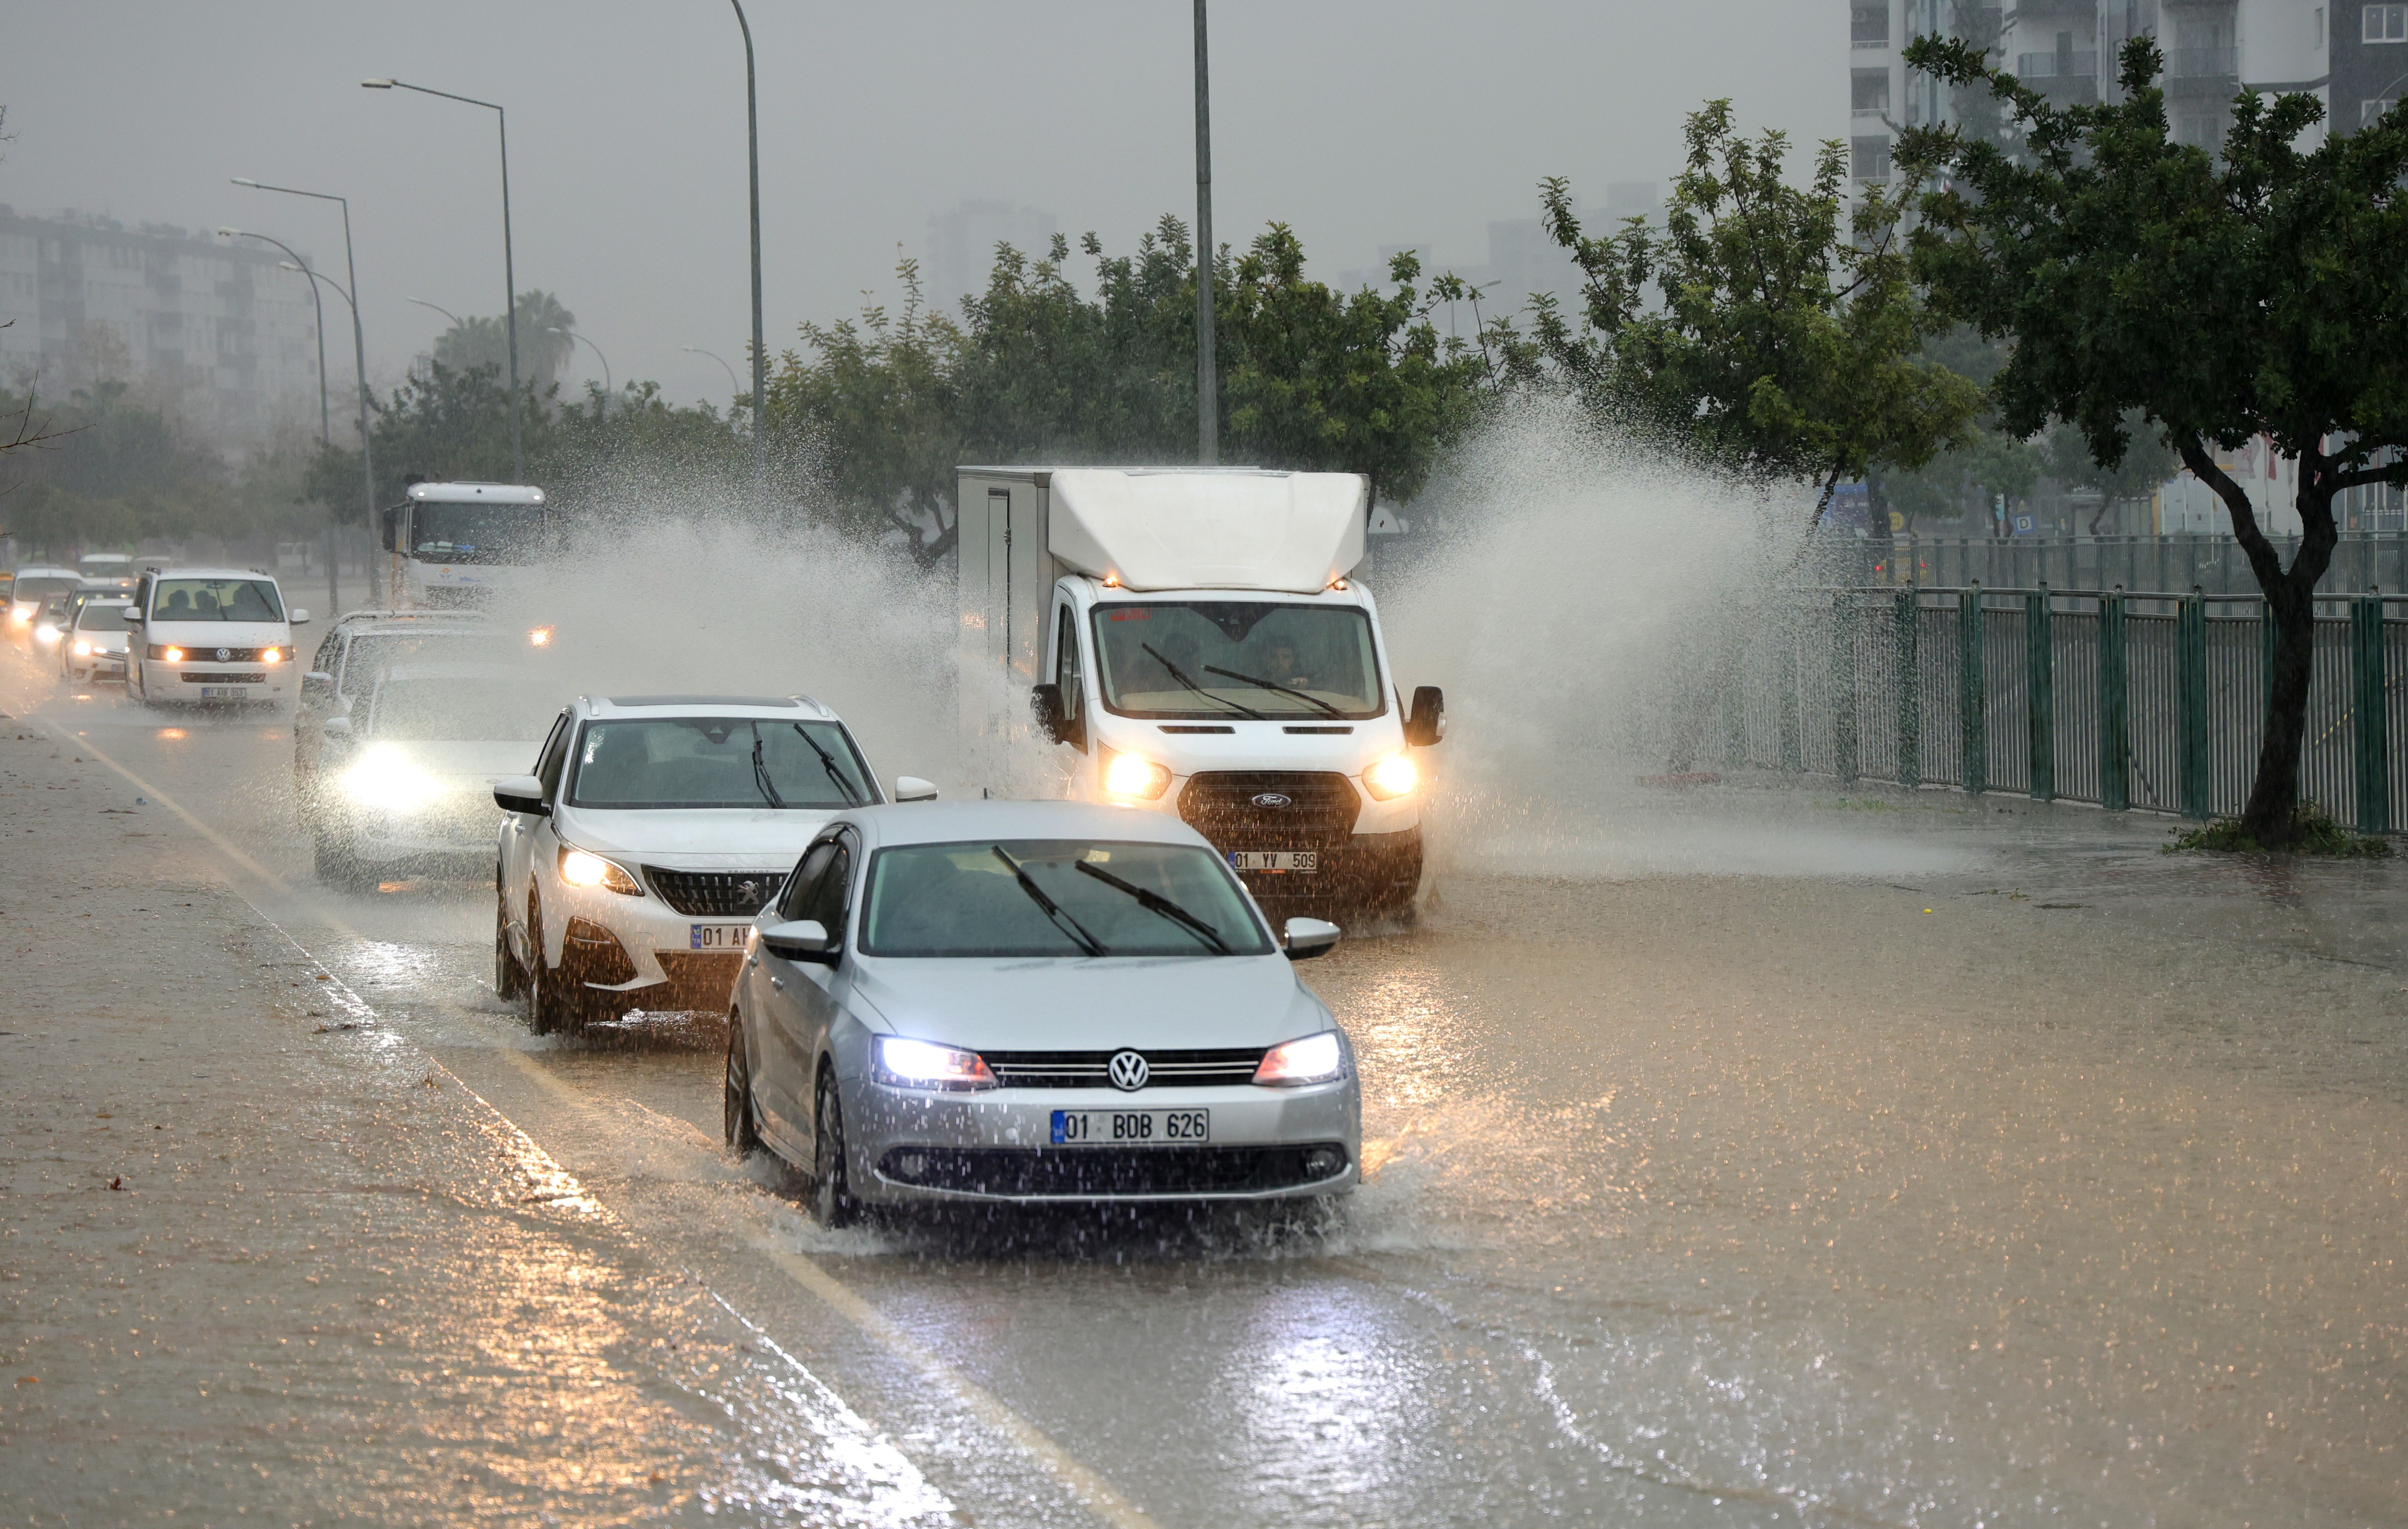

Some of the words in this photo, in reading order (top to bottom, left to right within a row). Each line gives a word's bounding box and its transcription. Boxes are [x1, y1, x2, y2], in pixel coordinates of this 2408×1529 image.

[1261, 795, 1283, 805] Ford
[1235, 853, 1248, 868] 01
[1262, 853, 1277, 868] YV
[1293, 853, 1316, 868] 509
[703, 928, 722, 945] 01
[1065, 1115, 1088, 1139] 01
[1113, 1114, 1152, 1139] BDB
[1167, 1114, 1205, 1138] 626
